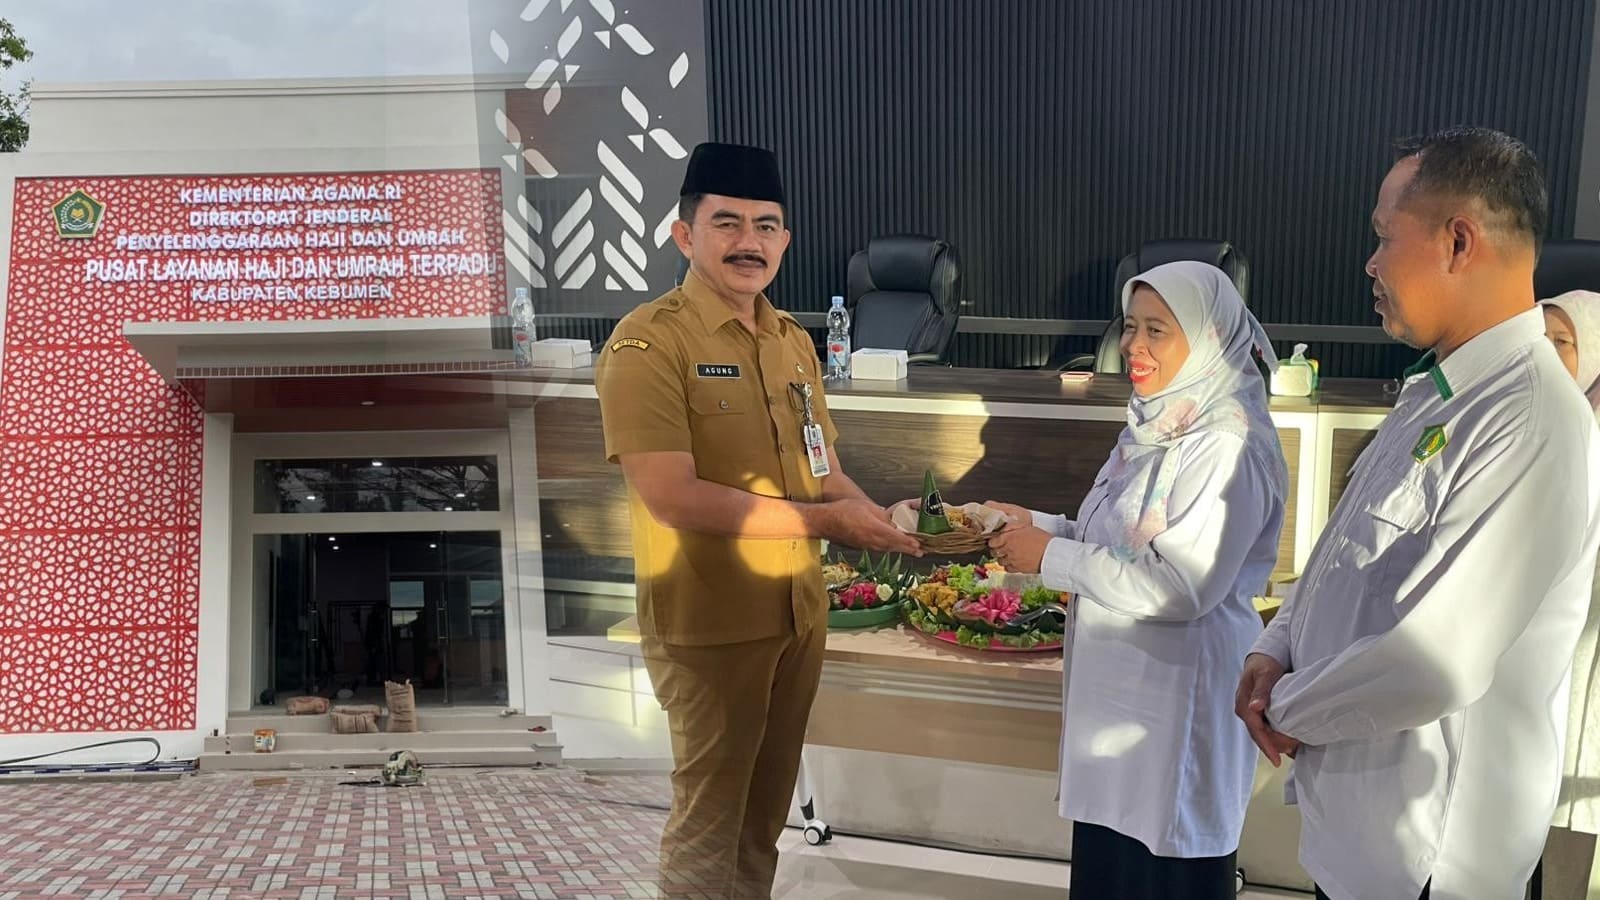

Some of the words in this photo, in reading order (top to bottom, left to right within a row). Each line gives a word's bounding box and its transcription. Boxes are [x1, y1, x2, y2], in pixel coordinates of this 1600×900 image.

[181, 186, 305, 203] KEMENTERIAN
[312, 185, 378, 201] AGAMA
[385, 185, 400, 200] RI
[189, 209, 299, 226] DIREKTORAT
[304, 208, 393, 224] JENDERAL
[116, 232, 299, 250] PENYELENGGARAAN
[305, 231, 345, 247] HAJI
[351, 230, 391, 247] DAN
[398, 230, 464, 246] UMRAH
[86, 258, 149, 281] PUSAT
[153, 257, 239, 281] LAYANAN
[245, 256, 286, 280] HAJI
[292, 255, 330, 279] DAN
[337, 254, 404, 278] UMRAH
[410, 252, 496, 276] TERPADU
[191, 285, 299, 302] KABUPATEN
[304, 283, 392, 300] KEBUMEN
[705, 367, 733, 375] AGUNG
